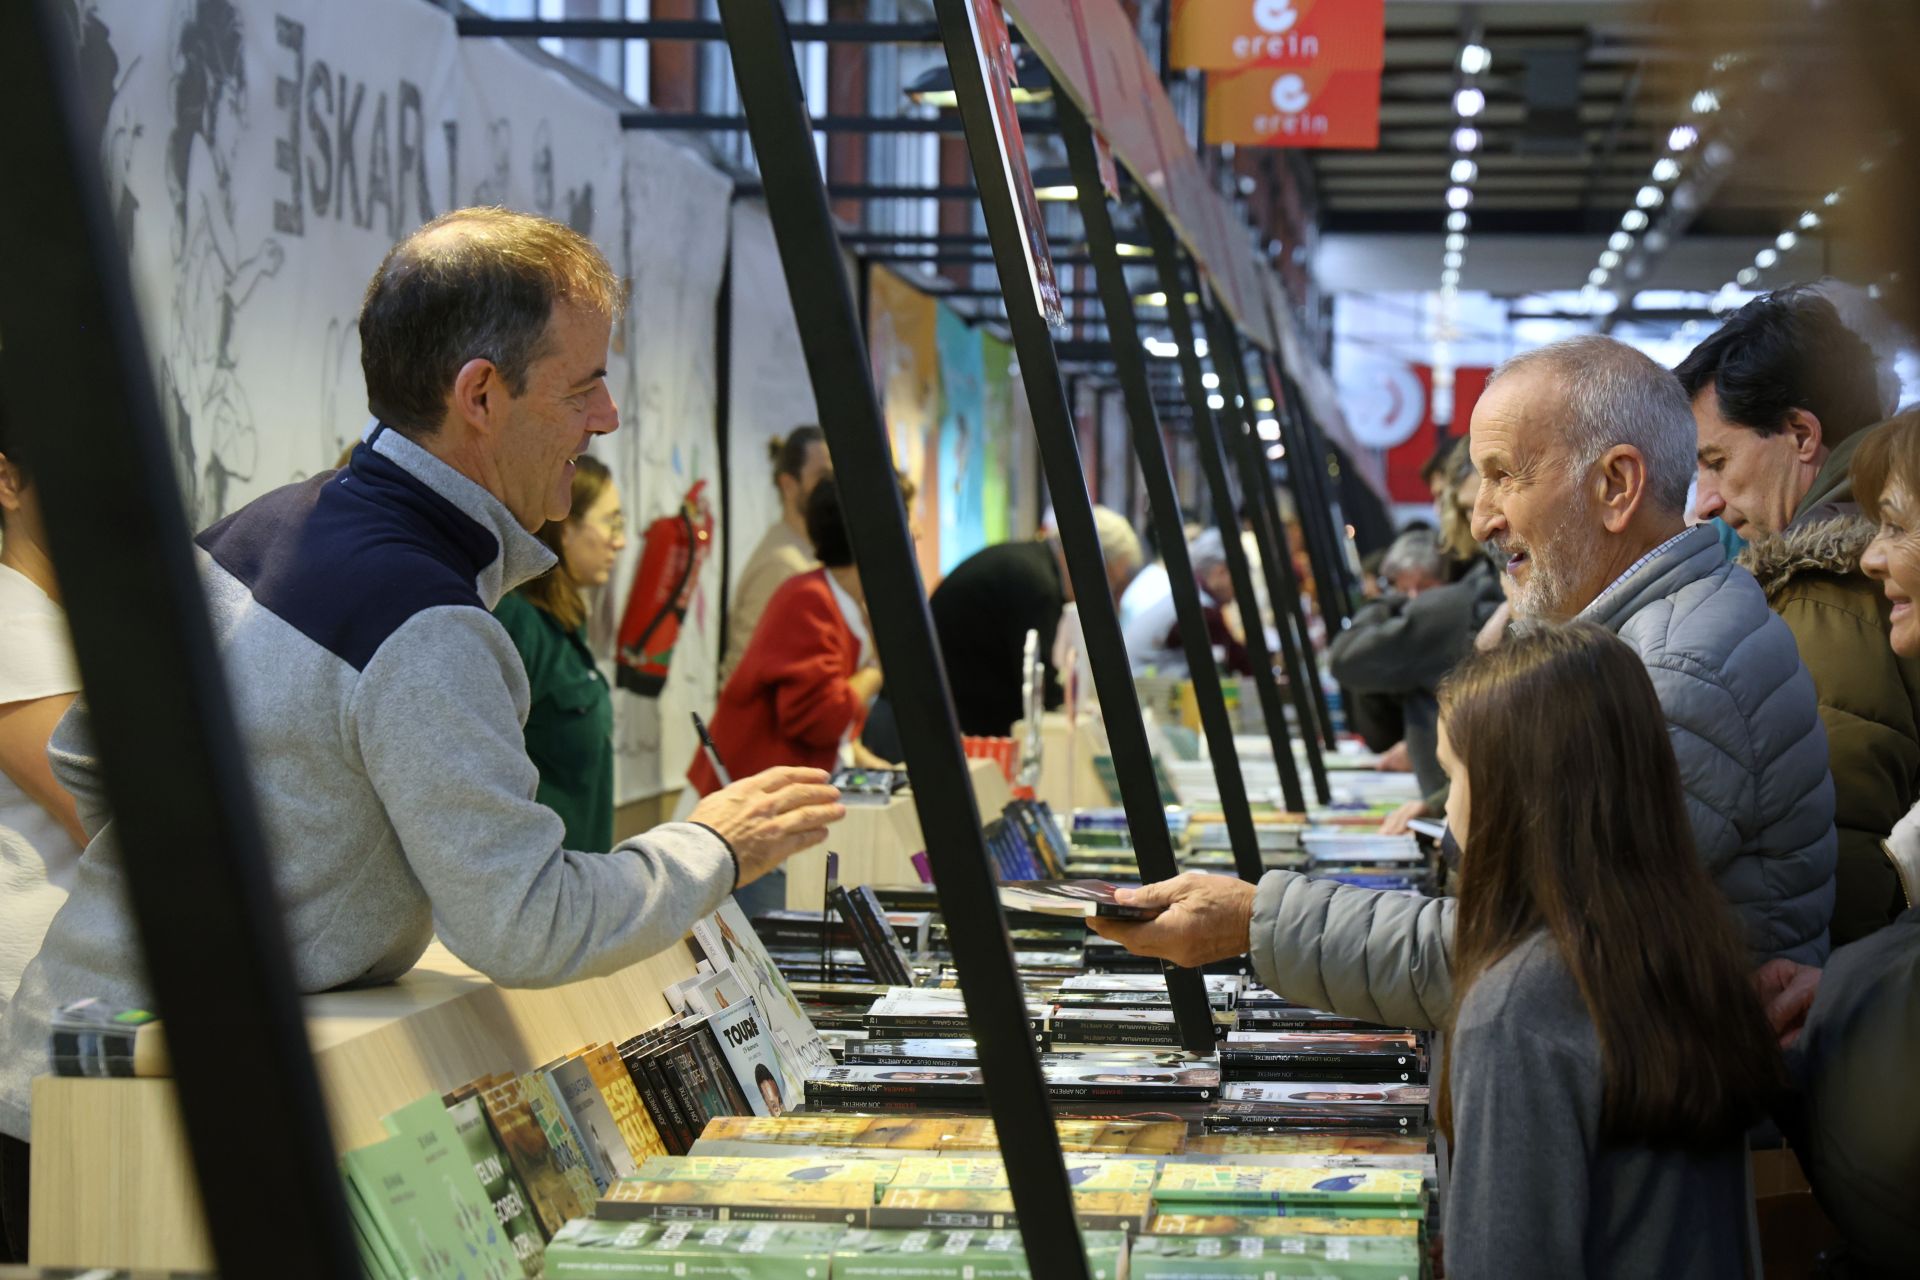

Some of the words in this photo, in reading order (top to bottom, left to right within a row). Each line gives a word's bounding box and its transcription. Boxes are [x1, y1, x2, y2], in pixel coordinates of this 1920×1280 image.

[1231, 32, 1319, 59] erein
[1252, 112, 1329, 136] erein
[723, 1012, 760, 1048] TOURÉ
[922, 1213, 988, 1227] RESET
